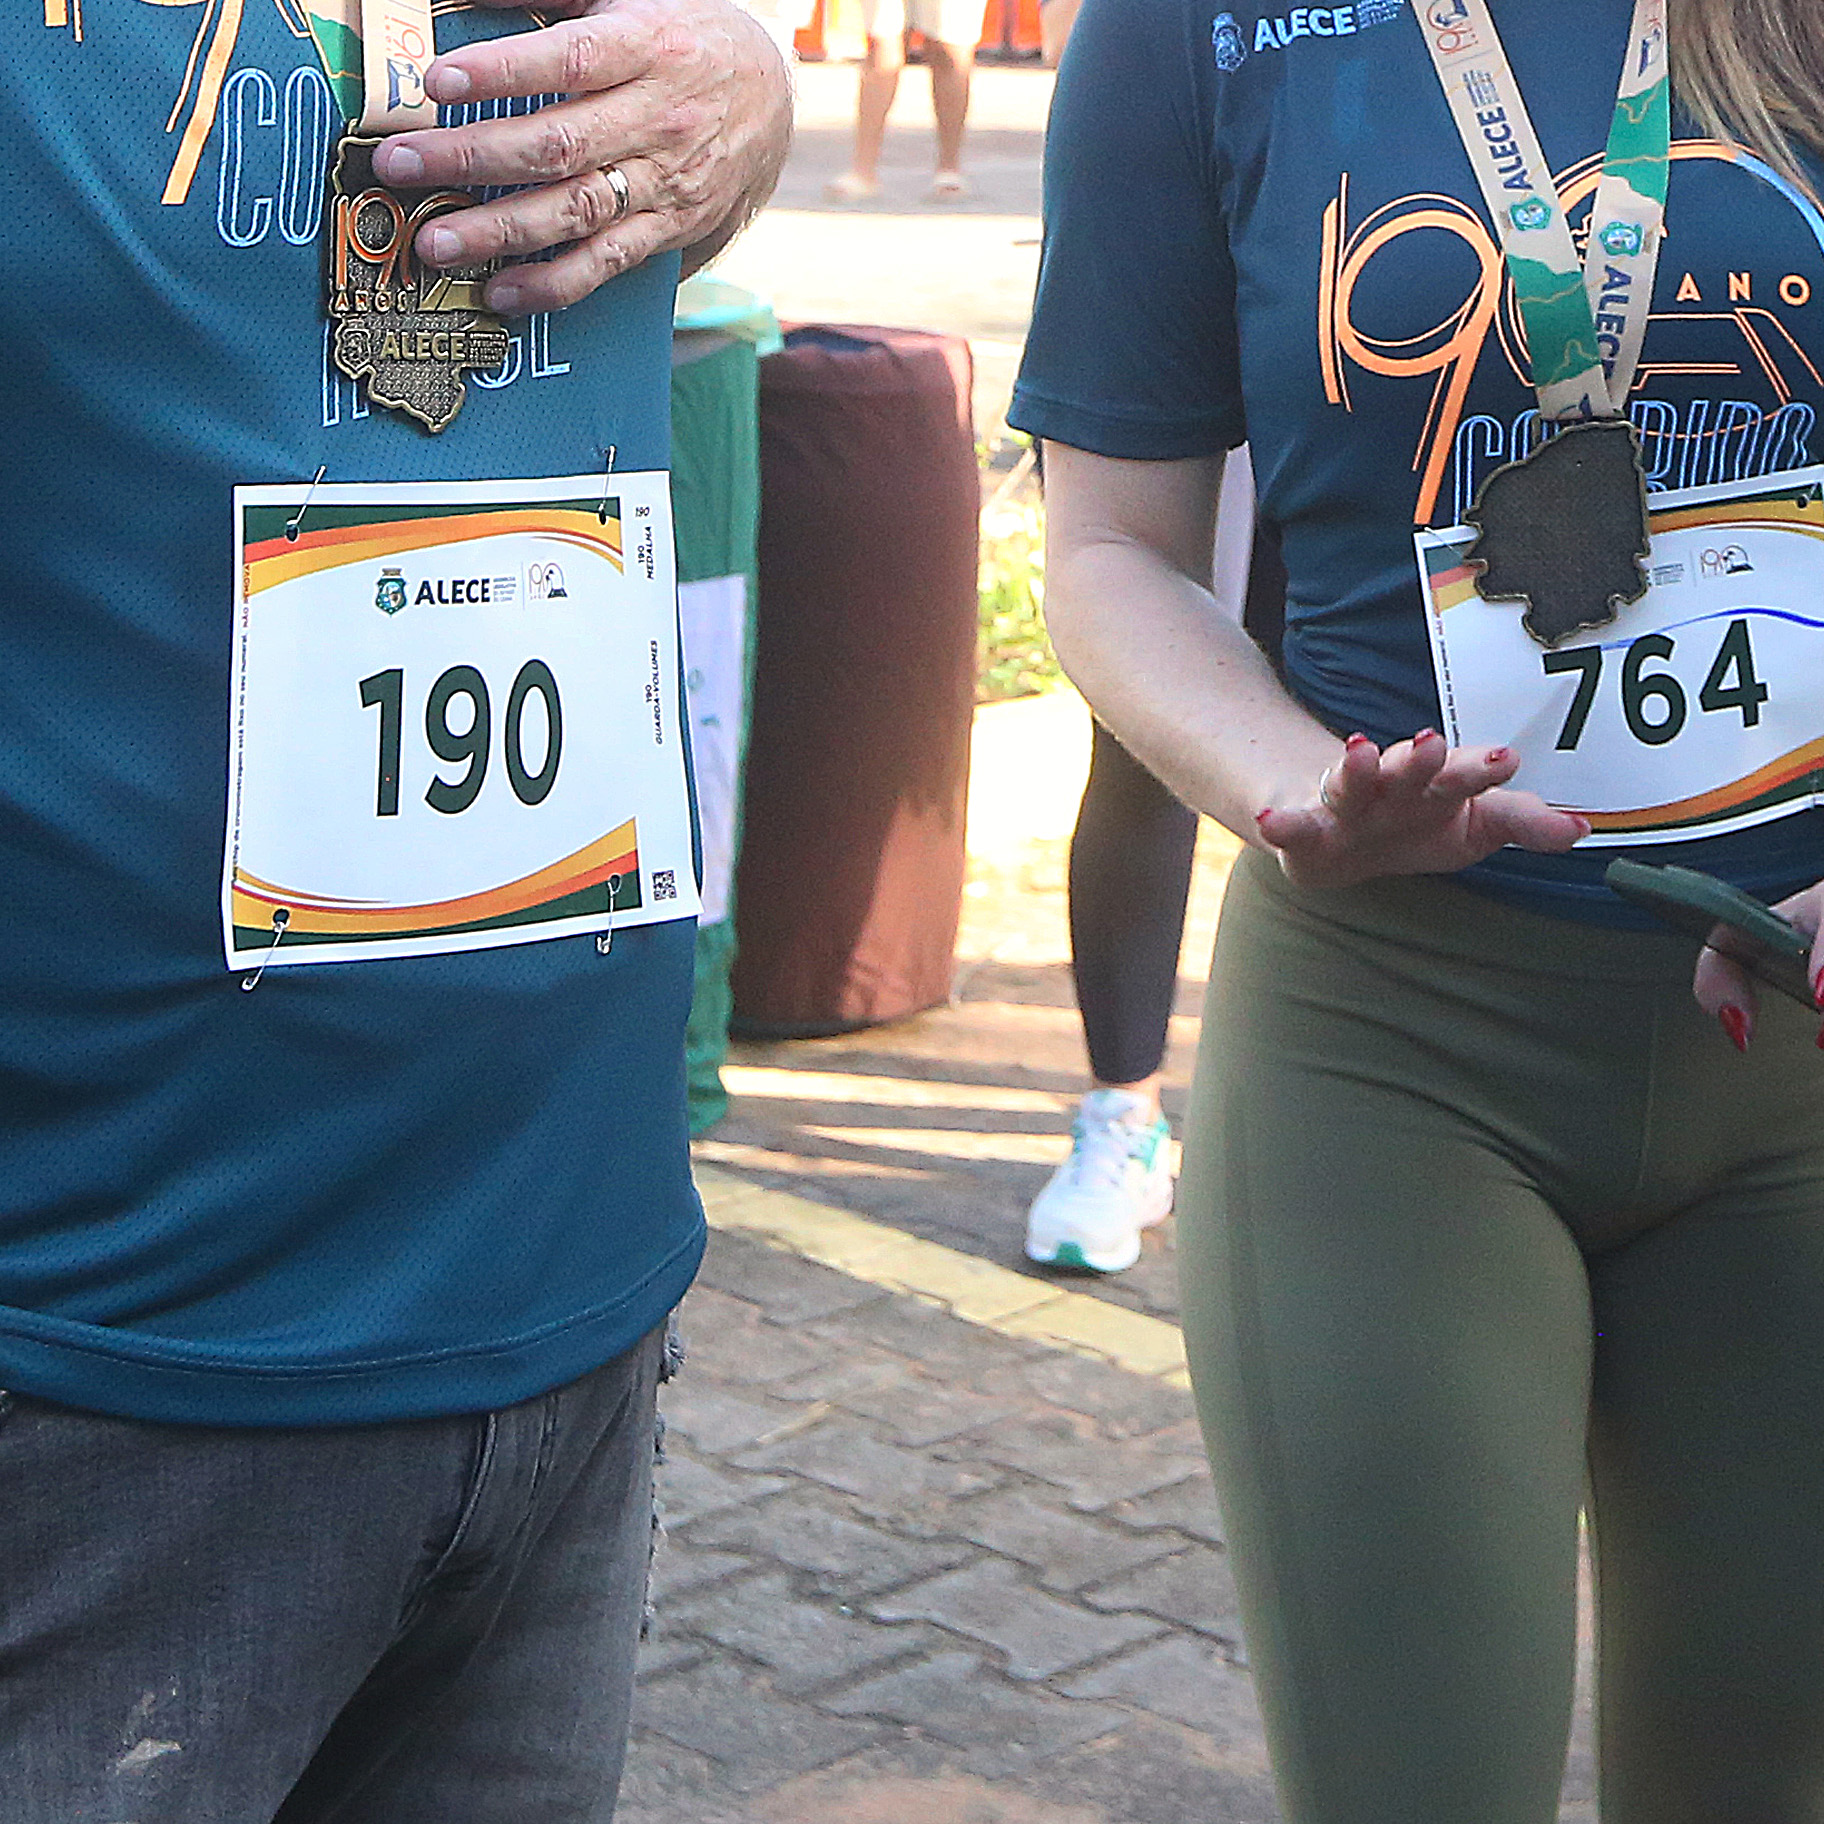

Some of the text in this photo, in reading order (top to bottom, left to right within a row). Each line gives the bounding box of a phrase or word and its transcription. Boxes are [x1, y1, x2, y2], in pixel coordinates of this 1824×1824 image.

[1253, 4, 1357, 54] ALECE
[1476, 105, 1535, 191] ALECE
[379, 329, 466, 362] ALECE
[644, 526, 654, 581] MEDALHA
[414, 577, 491, 606] ALECE
[1542, 618, 1768, 753] 764
[359, 658, 564, 818] 190
